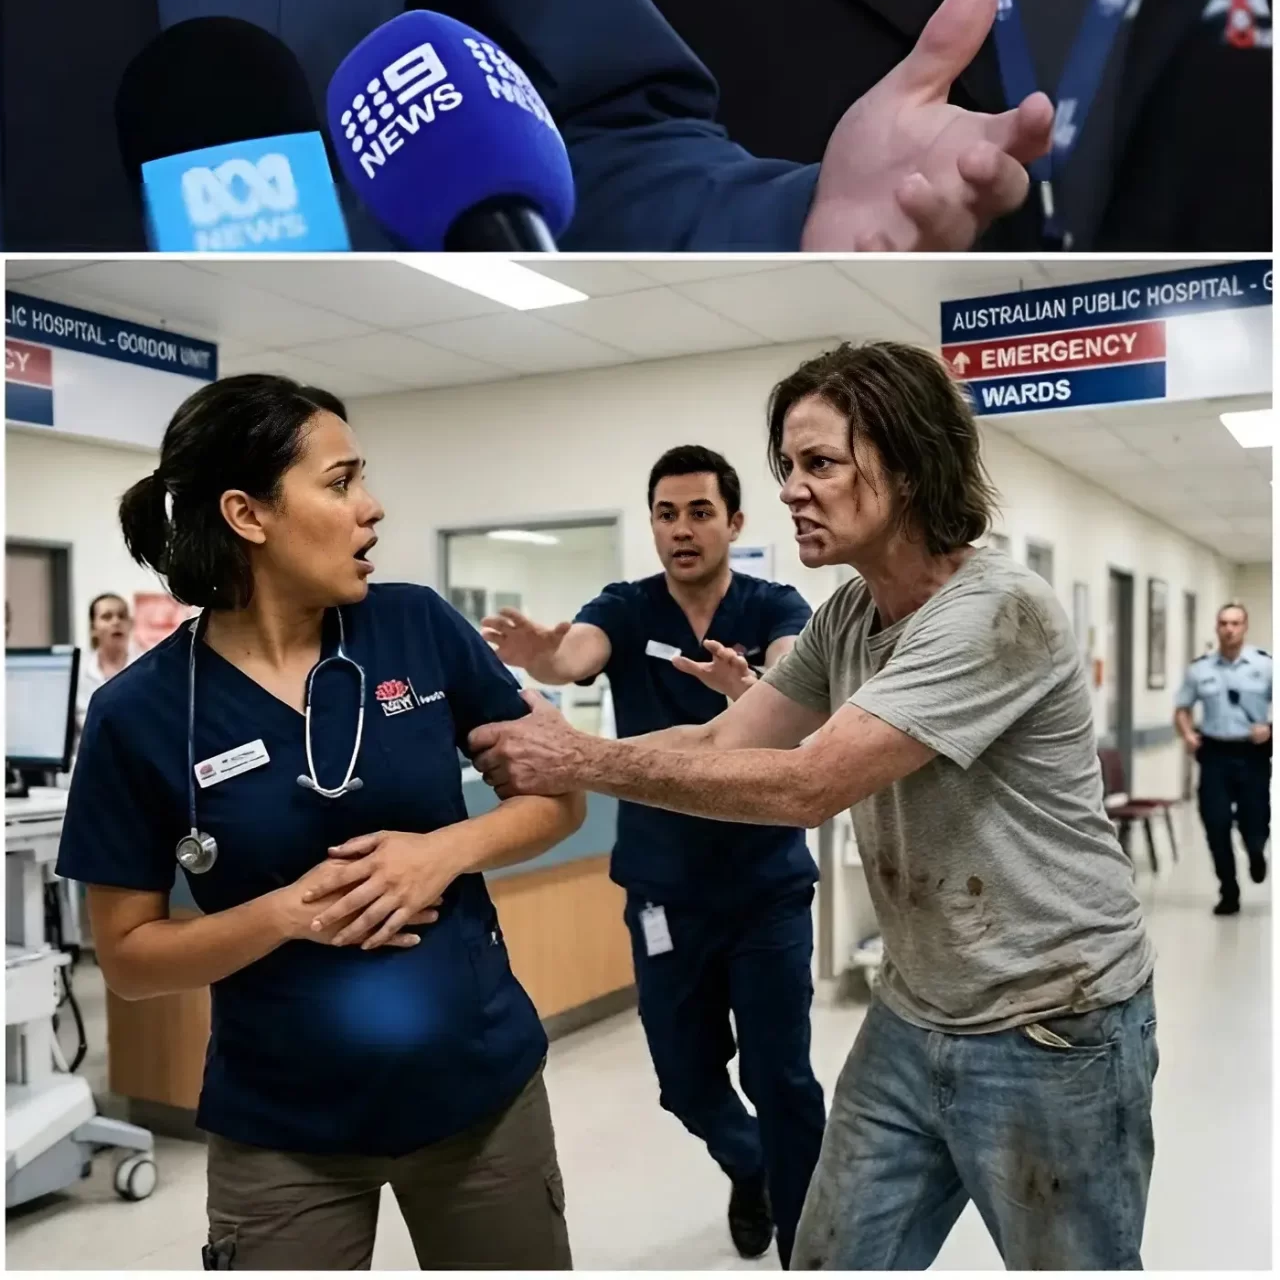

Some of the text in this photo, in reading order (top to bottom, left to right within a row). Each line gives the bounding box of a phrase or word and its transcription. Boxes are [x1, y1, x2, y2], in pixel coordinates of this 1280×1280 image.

[383, 42, 448, 105] 9
[359, 83, 463, 179] NEWS
[6, 304, 27, 328] IC
[32, 309, 106, 346] HOSPITAL
[953, 298, 1067, 331] AUSTRALIAN
[1072, 288, 1140, 315] PUBLIC
[1147, 275, 1243, 306] HOSPITAL
[981, 332, 1137, 370] EMERGENCY
[981, 378, 1071, 408] WARDS
